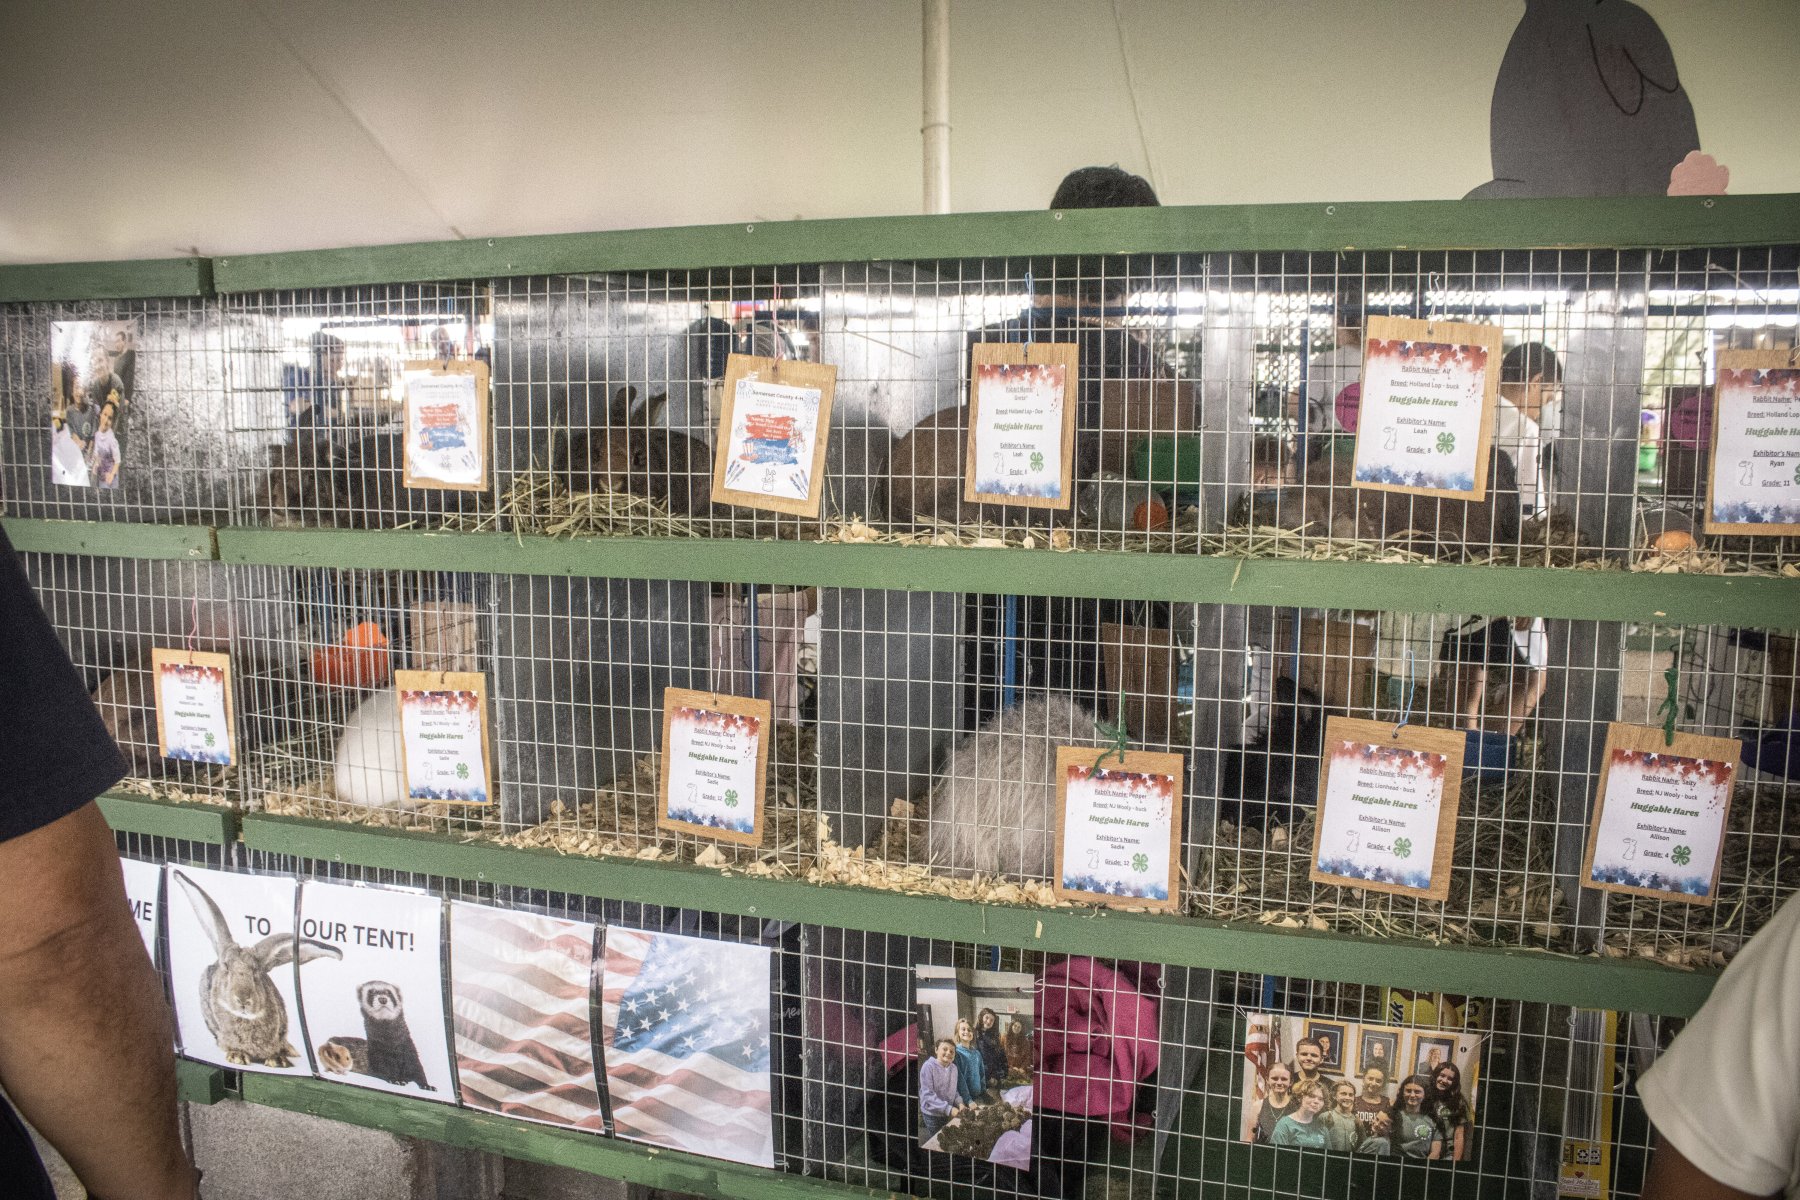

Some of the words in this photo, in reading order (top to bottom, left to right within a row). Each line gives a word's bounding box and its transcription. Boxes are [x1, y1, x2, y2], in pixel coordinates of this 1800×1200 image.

[1402, 365, 1420, 373] Rabbit
[753, 389, 776, 398] Somerset
[777, 392, 794, 400] County
[1753, 395, 1772, 403] Rabbit
[1389, 395, 1430, 406] Huggable
[1431, 397, 1458, 407] Hares
[993, 422, 1023, 431] Huggable
[1024, 423, 1043, 431] Hares
[1397, 417, 1427, 425] Exhibitor's
[1428, 419, 1447, 427] Name:
[1745, 427, 1788, 437] Huggable
[1406, 446, 1426, 454] Grade:
[688, 752, 718, 761] Huggable
[719, 757, 738, 765] Hares
[1360, 767, 1377, 775] Rabbit
[1378, 769, 1396, 778] Name:
[1397, 771, 1417, 780] Stormy
[1642, 774, 1660, 782] Rabbit
[1661, 776, 1680, 785] Name:
[1357, 780, 1374, 788] Breed:
[1375, 783, 1399, 791] Lionhead
[1129, 792, 1147, 800] Pepper
[1636, 788, 1655, 796] Breed:
[1663, 791, 1680, 799] Wooly
[1685, 793, 1698, 801] buck
[1352, 794, 1391, 806] Huggable
[1392, 799, 1418, 810] Hares
[1631, 802, 1672, 814] Huggable
[1673, 807, 1700, 817] Hares
[1089, 814, 1125, 825] Huggable
[1126, 818, 1149, 828] Hares
[1359, 814, 1388, 825] Exhibitor's
[1388, 819, 1406, 827] Name:
[1371, 825, 1390, 833] Allison
[1636, 823, 1667, 833] Exhibitor's
[1668, 827, 1687, 835] Name:
[1096, 834, 1123, 842] Exhibitor's
[1367, 842, 1385, 851] Grade:
[1643, 850, 1663, 858] Grade:
[245, 915, 271, 936] TO
[303, 919, 347, 942] OUR
[353, 925, 414, 951] TENT!
